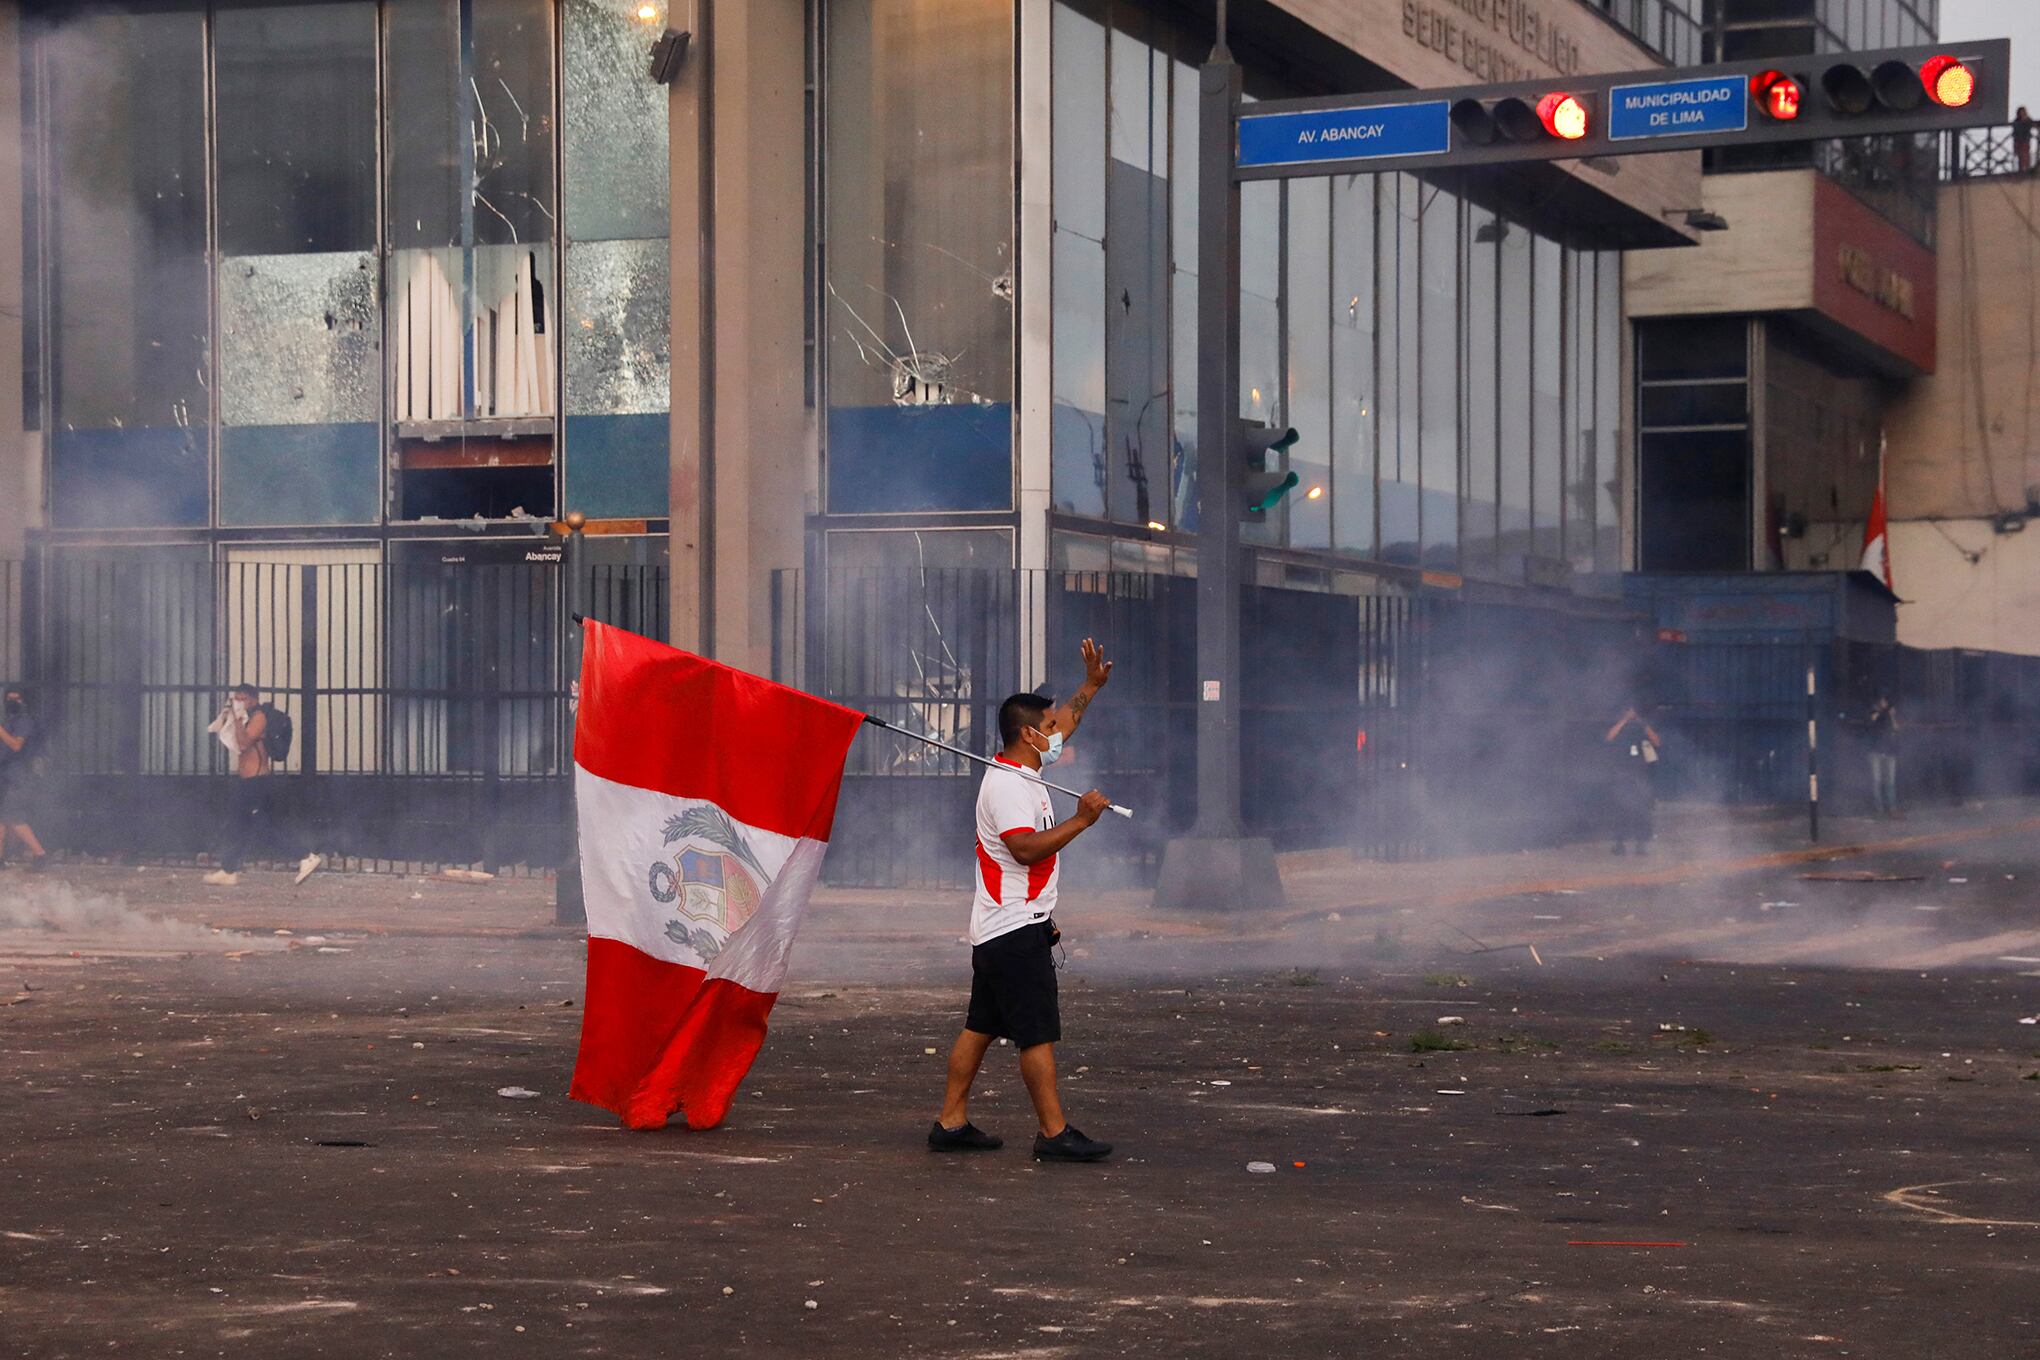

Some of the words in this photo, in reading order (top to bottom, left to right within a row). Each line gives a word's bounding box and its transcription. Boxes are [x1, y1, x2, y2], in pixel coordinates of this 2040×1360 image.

[1402, 0, 1458, 64] SEDE
[1624, 87, 1732, 110] MUNICIPALIDAD
[1649, 112, 1669, 127] DE
[1671, 110, 1705, 125] LIMA
[1297, 130, 1319, 145] AV.
[1320, 123, 1385, 143] ABANCAY
[525, 551, 562, 563] Abancay
